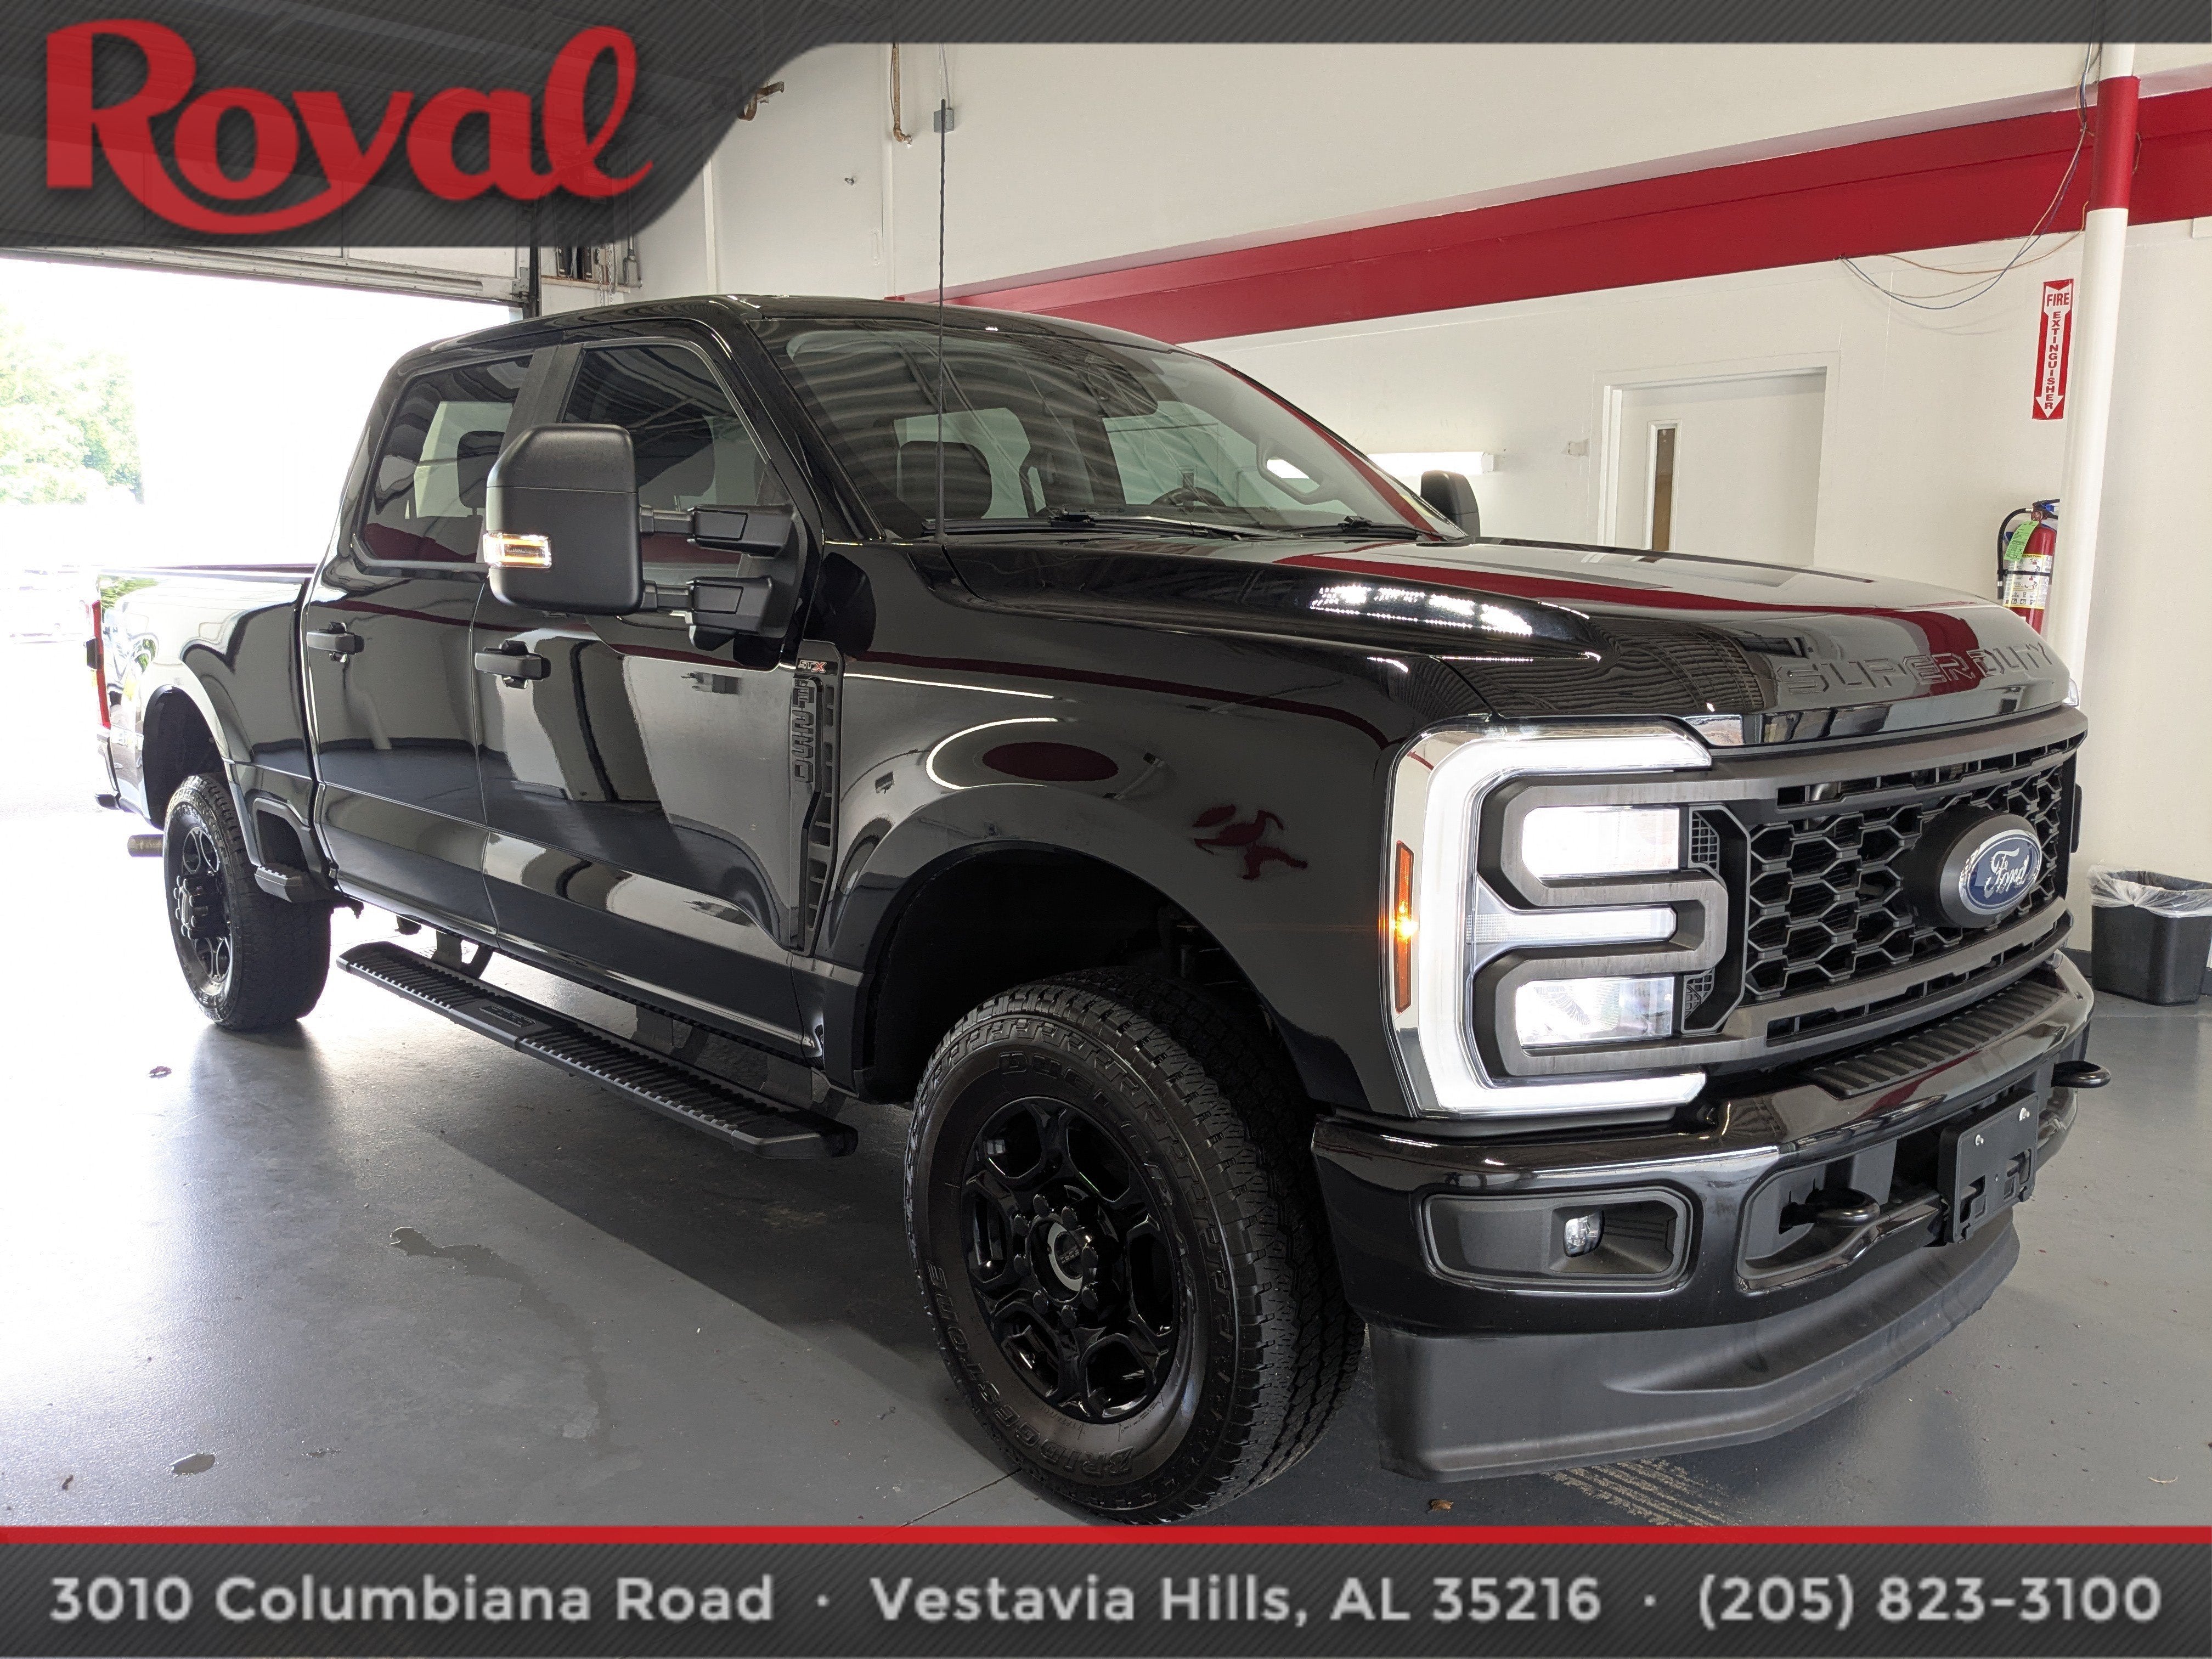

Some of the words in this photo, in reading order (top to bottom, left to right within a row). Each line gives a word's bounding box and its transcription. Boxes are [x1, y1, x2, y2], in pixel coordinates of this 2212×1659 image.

[2046, 292, 2069, 307] FIRE
[2044, 311, 2061, 410] EXTINGUISHER
[798, 660, 826, 673] STX
[1984, 848, 2030, 899] Ford
